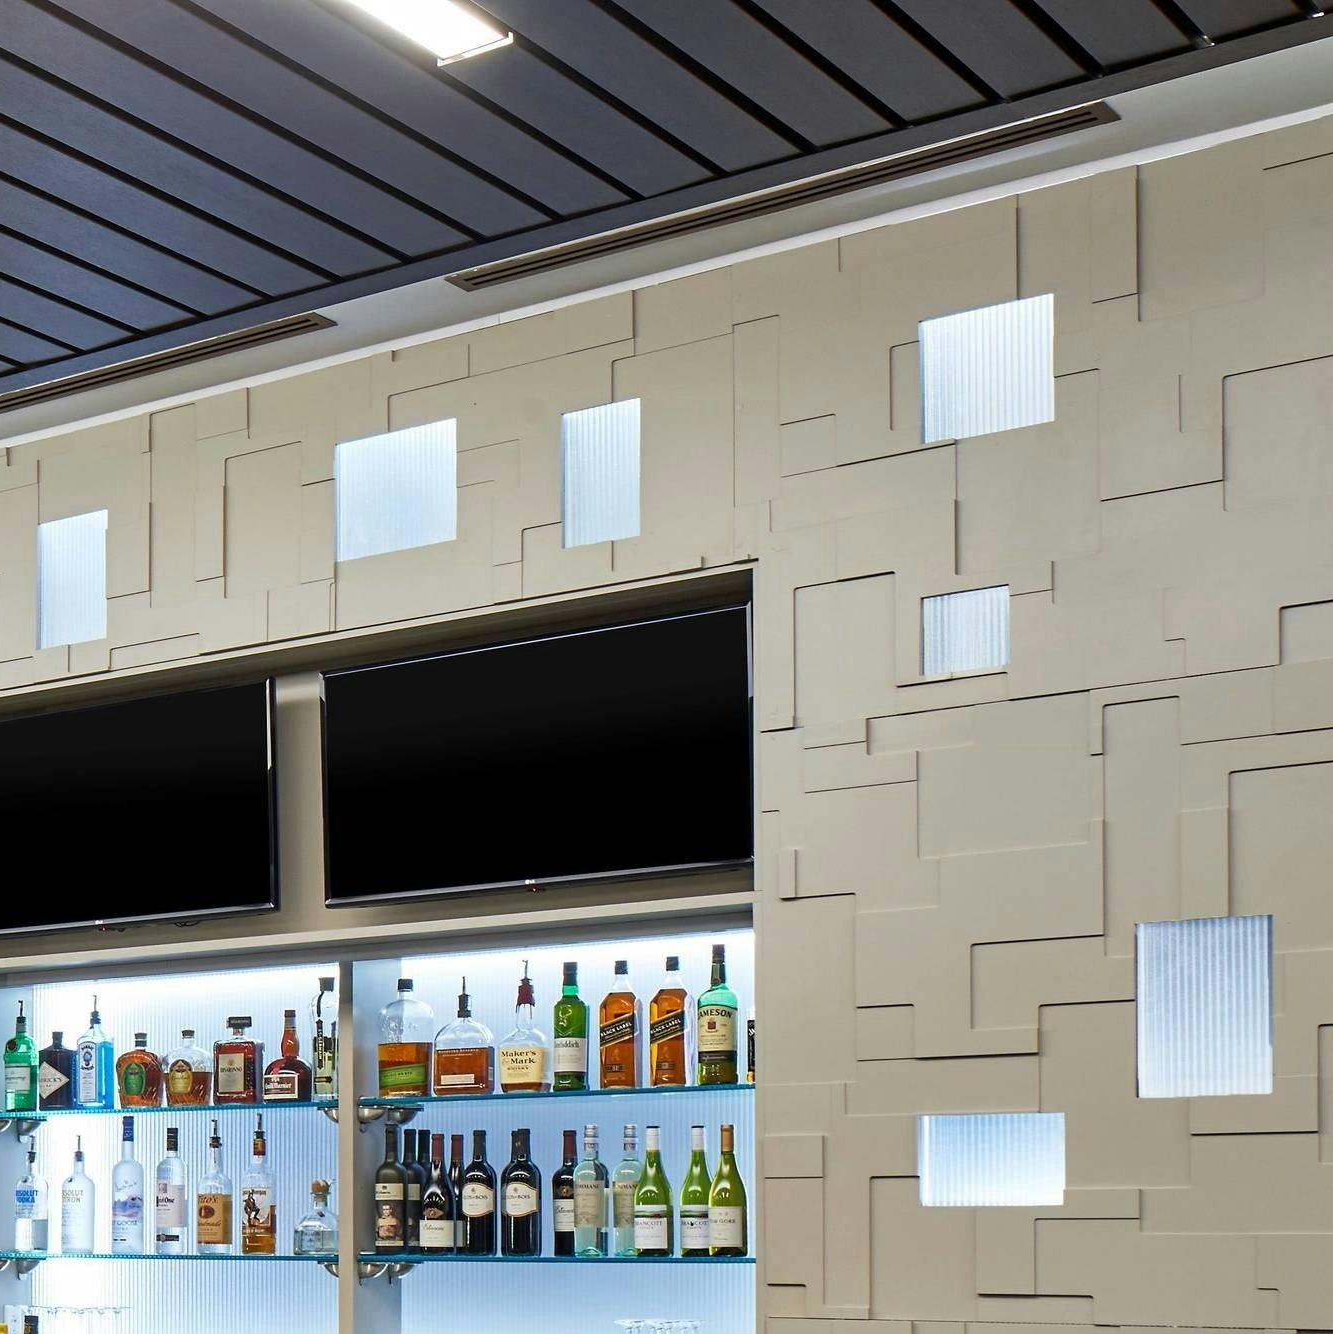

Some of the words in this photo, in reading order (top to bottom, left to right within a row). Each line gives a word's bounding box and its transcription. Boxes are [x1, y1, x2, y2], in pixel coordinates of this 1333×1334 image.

[617, 1022, 632, 1031] LABEL
[666, 1019, 681, 1028] LABEL
[510, 1057, 536, 1065] Mark
